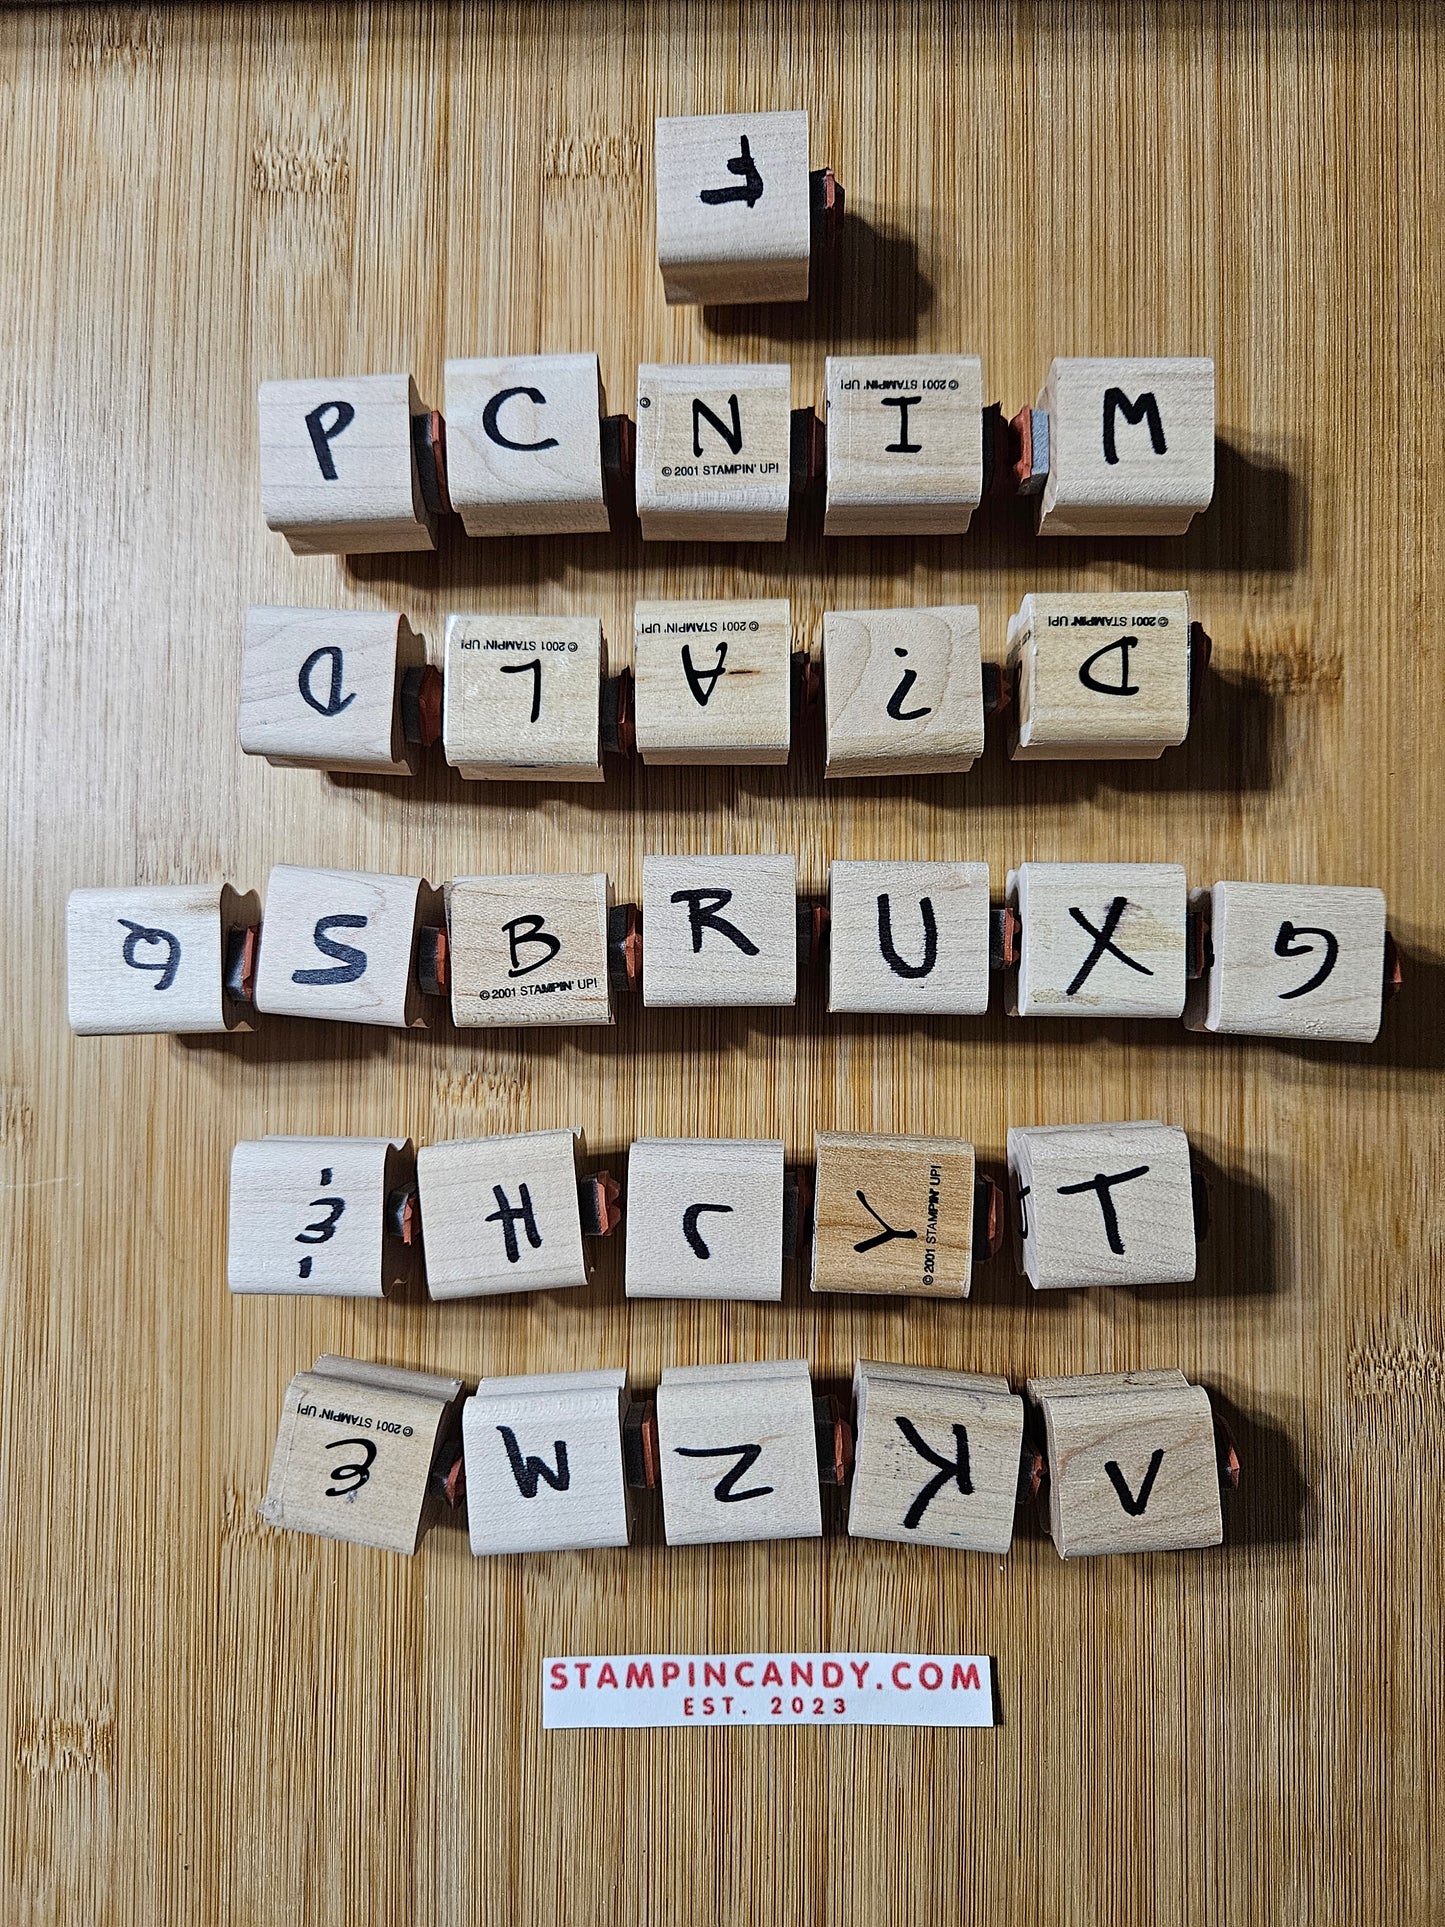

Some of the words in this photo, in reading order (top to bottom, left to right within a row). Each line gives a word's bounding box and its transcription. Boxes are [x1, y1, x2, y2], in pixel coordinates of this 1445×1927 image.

[305, 401, 354, 480] P
[483, 387, 560, 452] C
[692, 394, 742, 457] N
[881, 396, 922, 453] I
[1103, 387, 1168, 465] M
[703, 464, 756, 476] STAMPIN'
[664, 622, 718, 633] STAMPIN'
[500, 659, 541, 723] L
[682, 642, 727, 706] A
[1079, 636, 1139, 696] D
[292, 915, 367, 986] S
[502, 914, 561, 978] B
[671, 888, 760, 956] R
[877, 894, 938, 978] U
[1066, 897, 1154, 996] X
[485, 1182, 542, 1263] H
[853, 1190, 917, 1253] Y
[1057, 1165, 1149, 1255] T
[894, 1416, 975, 1529] K
[550, 1661, 981, 1690] STAMPINCANDY.COM
[684, 1697, 748, 1716] EST.
[771, 1697, 847, 1715] 2023
